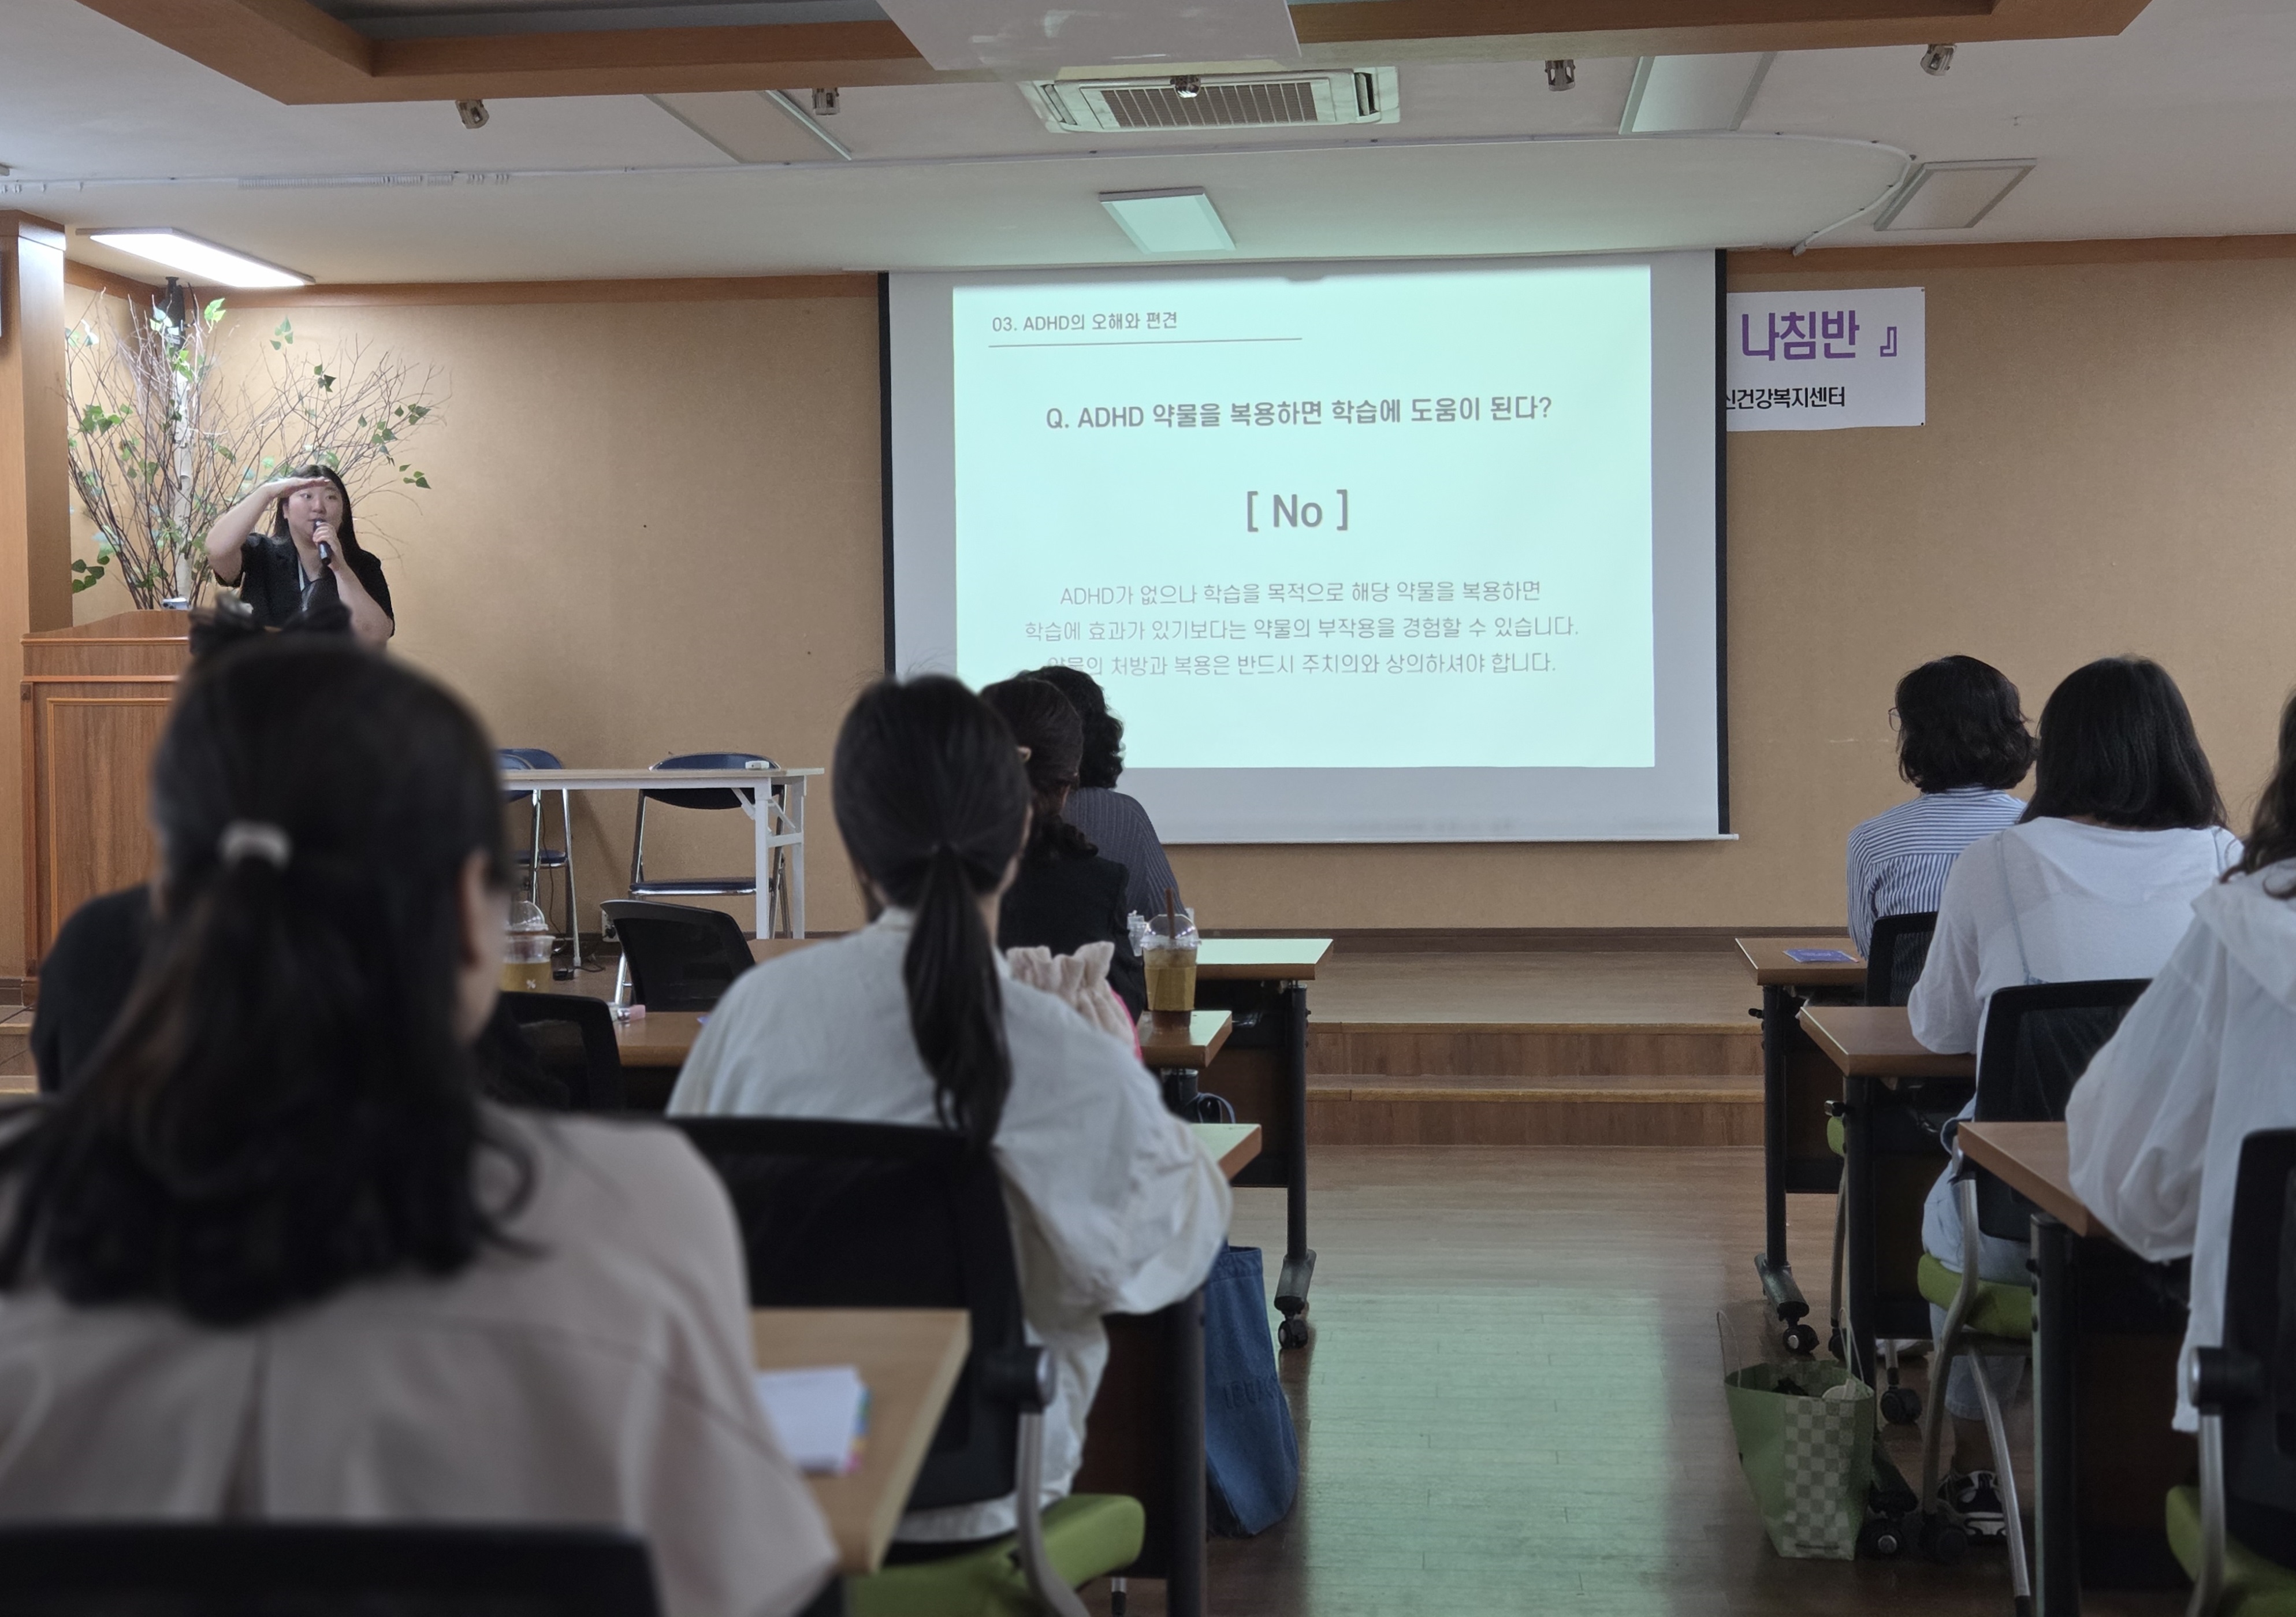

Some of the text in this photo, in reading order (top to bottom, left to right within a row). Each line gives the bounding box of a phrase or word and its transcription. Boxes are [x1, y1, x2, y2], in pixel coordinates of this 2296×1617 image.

[992, 311, 1177, 332] 03. ADHD의 오해와 편견
[1742, 310, 1860, 360] 나침반
[1046, 395, 1551, 429] Q. ADHD 약물을 복용하면 학습에 도움이 된다?
[1273, 494, 1323, 528] No
[1060, 581, 1540, 605] ADHD가 없으나 학습을 목적으로 해당 약물을 복용하면
[1025, 616, 1579, 642] 학습에 효과가 있기보다는 약물의 부작용을 경험할 수 있습니다.
[1111, 656, 1169, 676] 처방과
[1174, 655, 1230, 676] 복용은
[1238, 654, 1293, 675] 반드시
[1302, 653, 1380, 675] 주치의와
[1386, 653, 1486, 675] 상의하셔야
[1491, 652, 1556, 674] 합니다.
